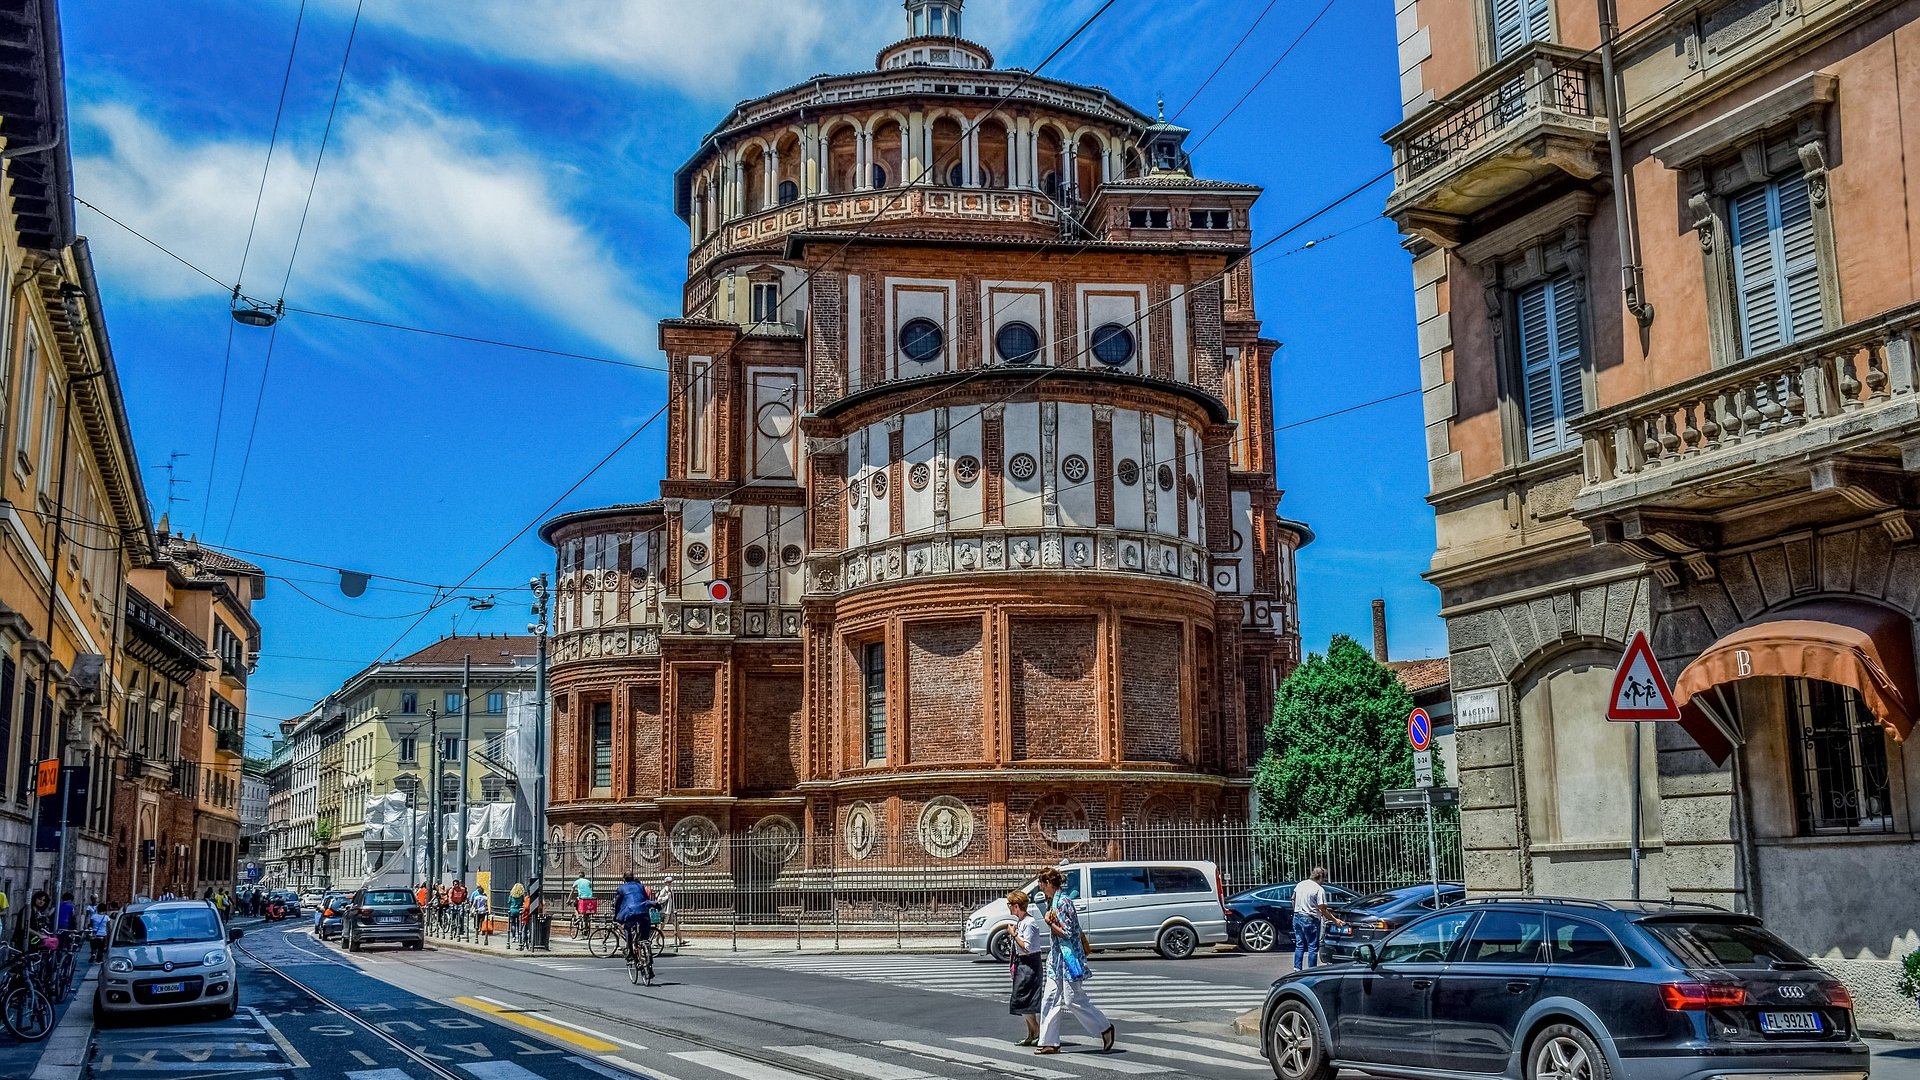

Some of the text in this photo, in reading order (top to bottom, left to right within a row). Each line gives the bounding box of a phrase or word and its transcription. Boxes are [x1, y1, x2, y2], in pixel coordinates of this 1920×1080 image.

[1735, 650, 1751, 677] B
[1462, 706, 1494, 717] MAGENTA
[39, 767, 56, 788] TAXI
[309, 1018, 484, 1037] BUS
[100, 1042, 268, 1072] TAXI
[349, 1040, 565, 1066] TAXI
